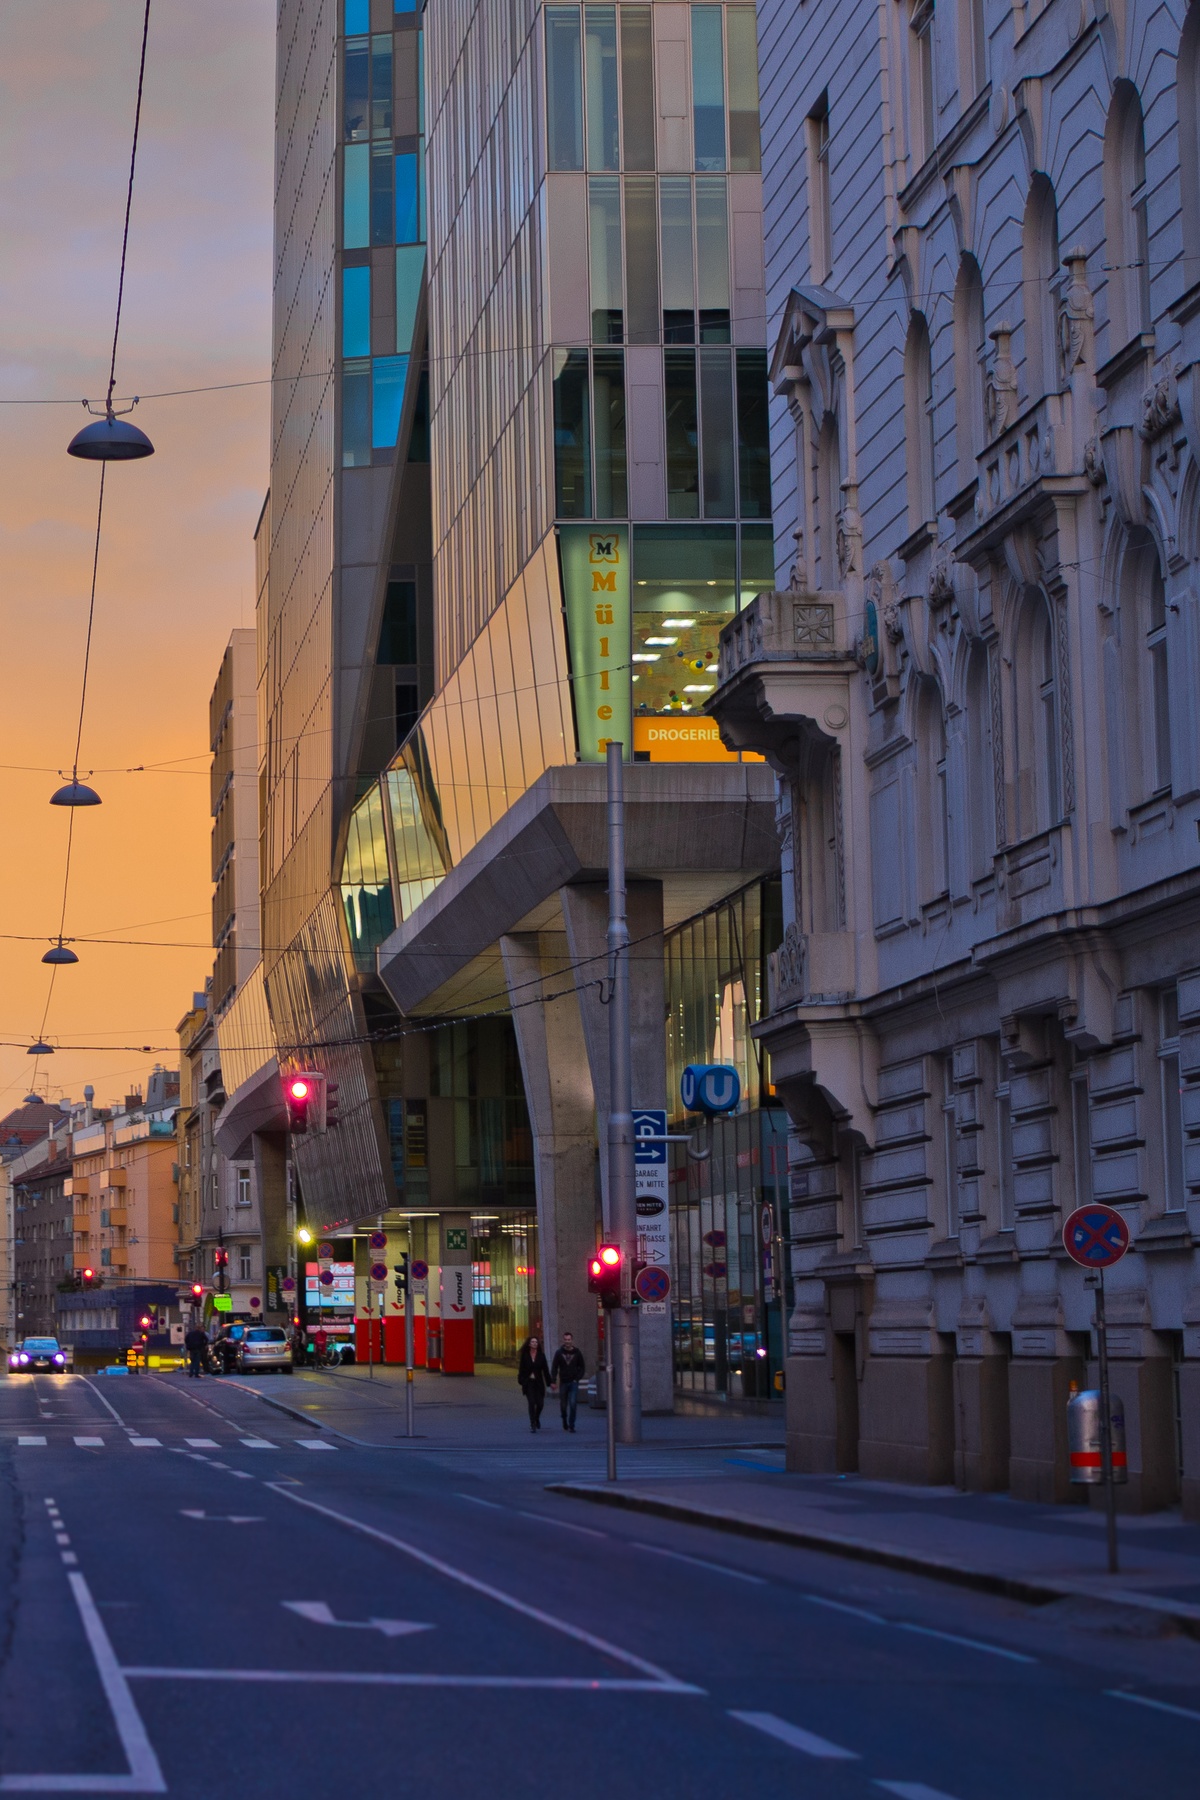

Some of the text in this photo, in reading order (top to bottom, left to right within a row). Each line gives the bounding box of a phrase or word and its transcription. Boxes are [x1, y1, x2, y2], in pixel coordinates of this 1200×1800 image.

[596, 541, 612, 556] M
[591, 571, 617, 754] Müller
[648, 729, 719, 741] DROGERIE
[682, 1074, 694, 1106] U
[705, 1074, 733, 1106] U
[647, 1180, 665, 1188] MITTE
[268, 1272, 277, 1309] SUBWAY
[455, 1271, 463, 1305] mondi
[646, 1304, 662, 1312] Ende
